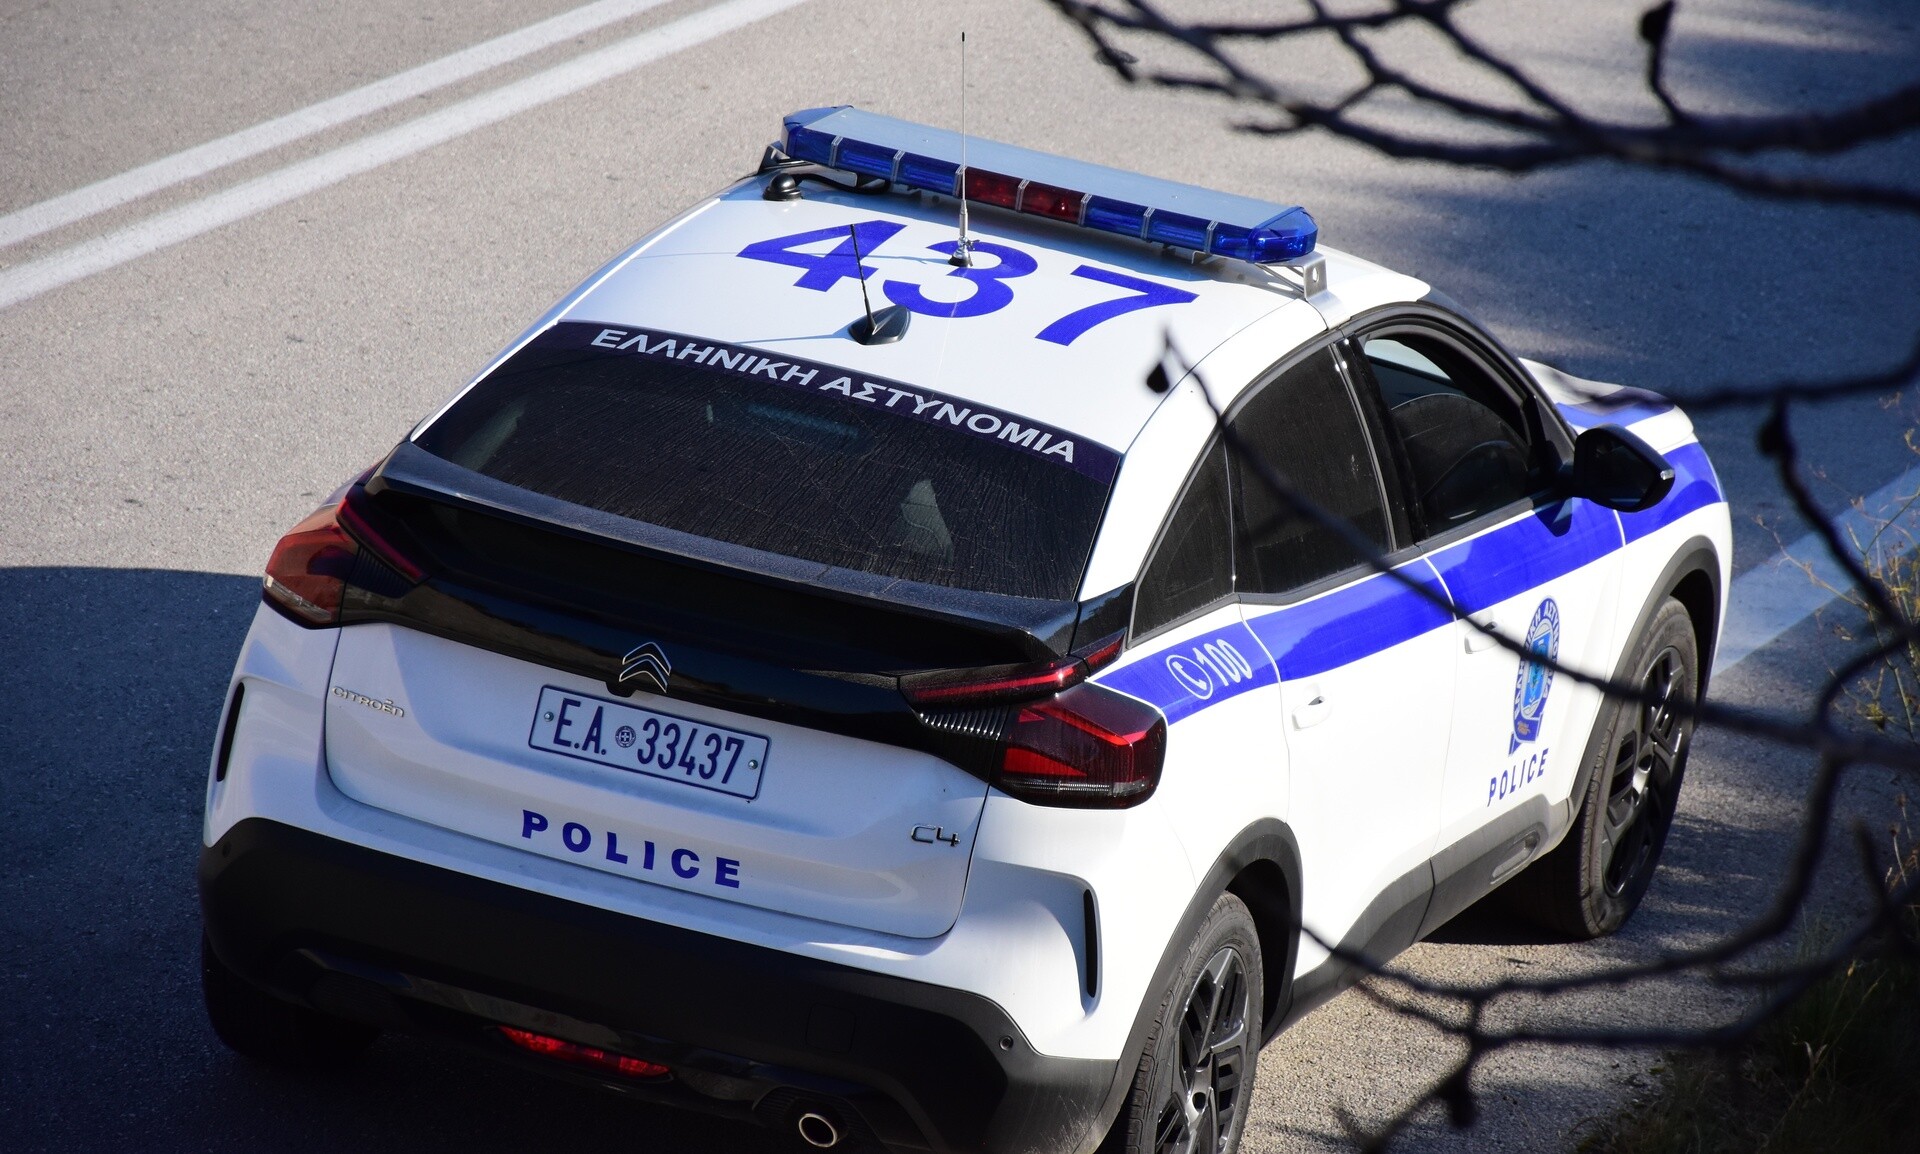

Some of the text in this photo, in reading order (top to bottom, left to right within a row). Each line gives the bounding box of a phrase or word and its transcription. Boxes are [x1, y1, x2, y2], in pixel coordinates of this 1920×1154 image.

[736, 219, 1200, 347] 437
[590, 328, 1076, 464] ΕΛΛΗΝΙΚΗ ΑΣΤΥΝΟΜΙΑ
[1192, 638, 1253, 687] 100
[636, 717, 745, 785] 33437
[1487, 747, 1549, 808] POLICE
[521, 809, 740, 889] POLICE
[911, 823, 961, 848] C4
